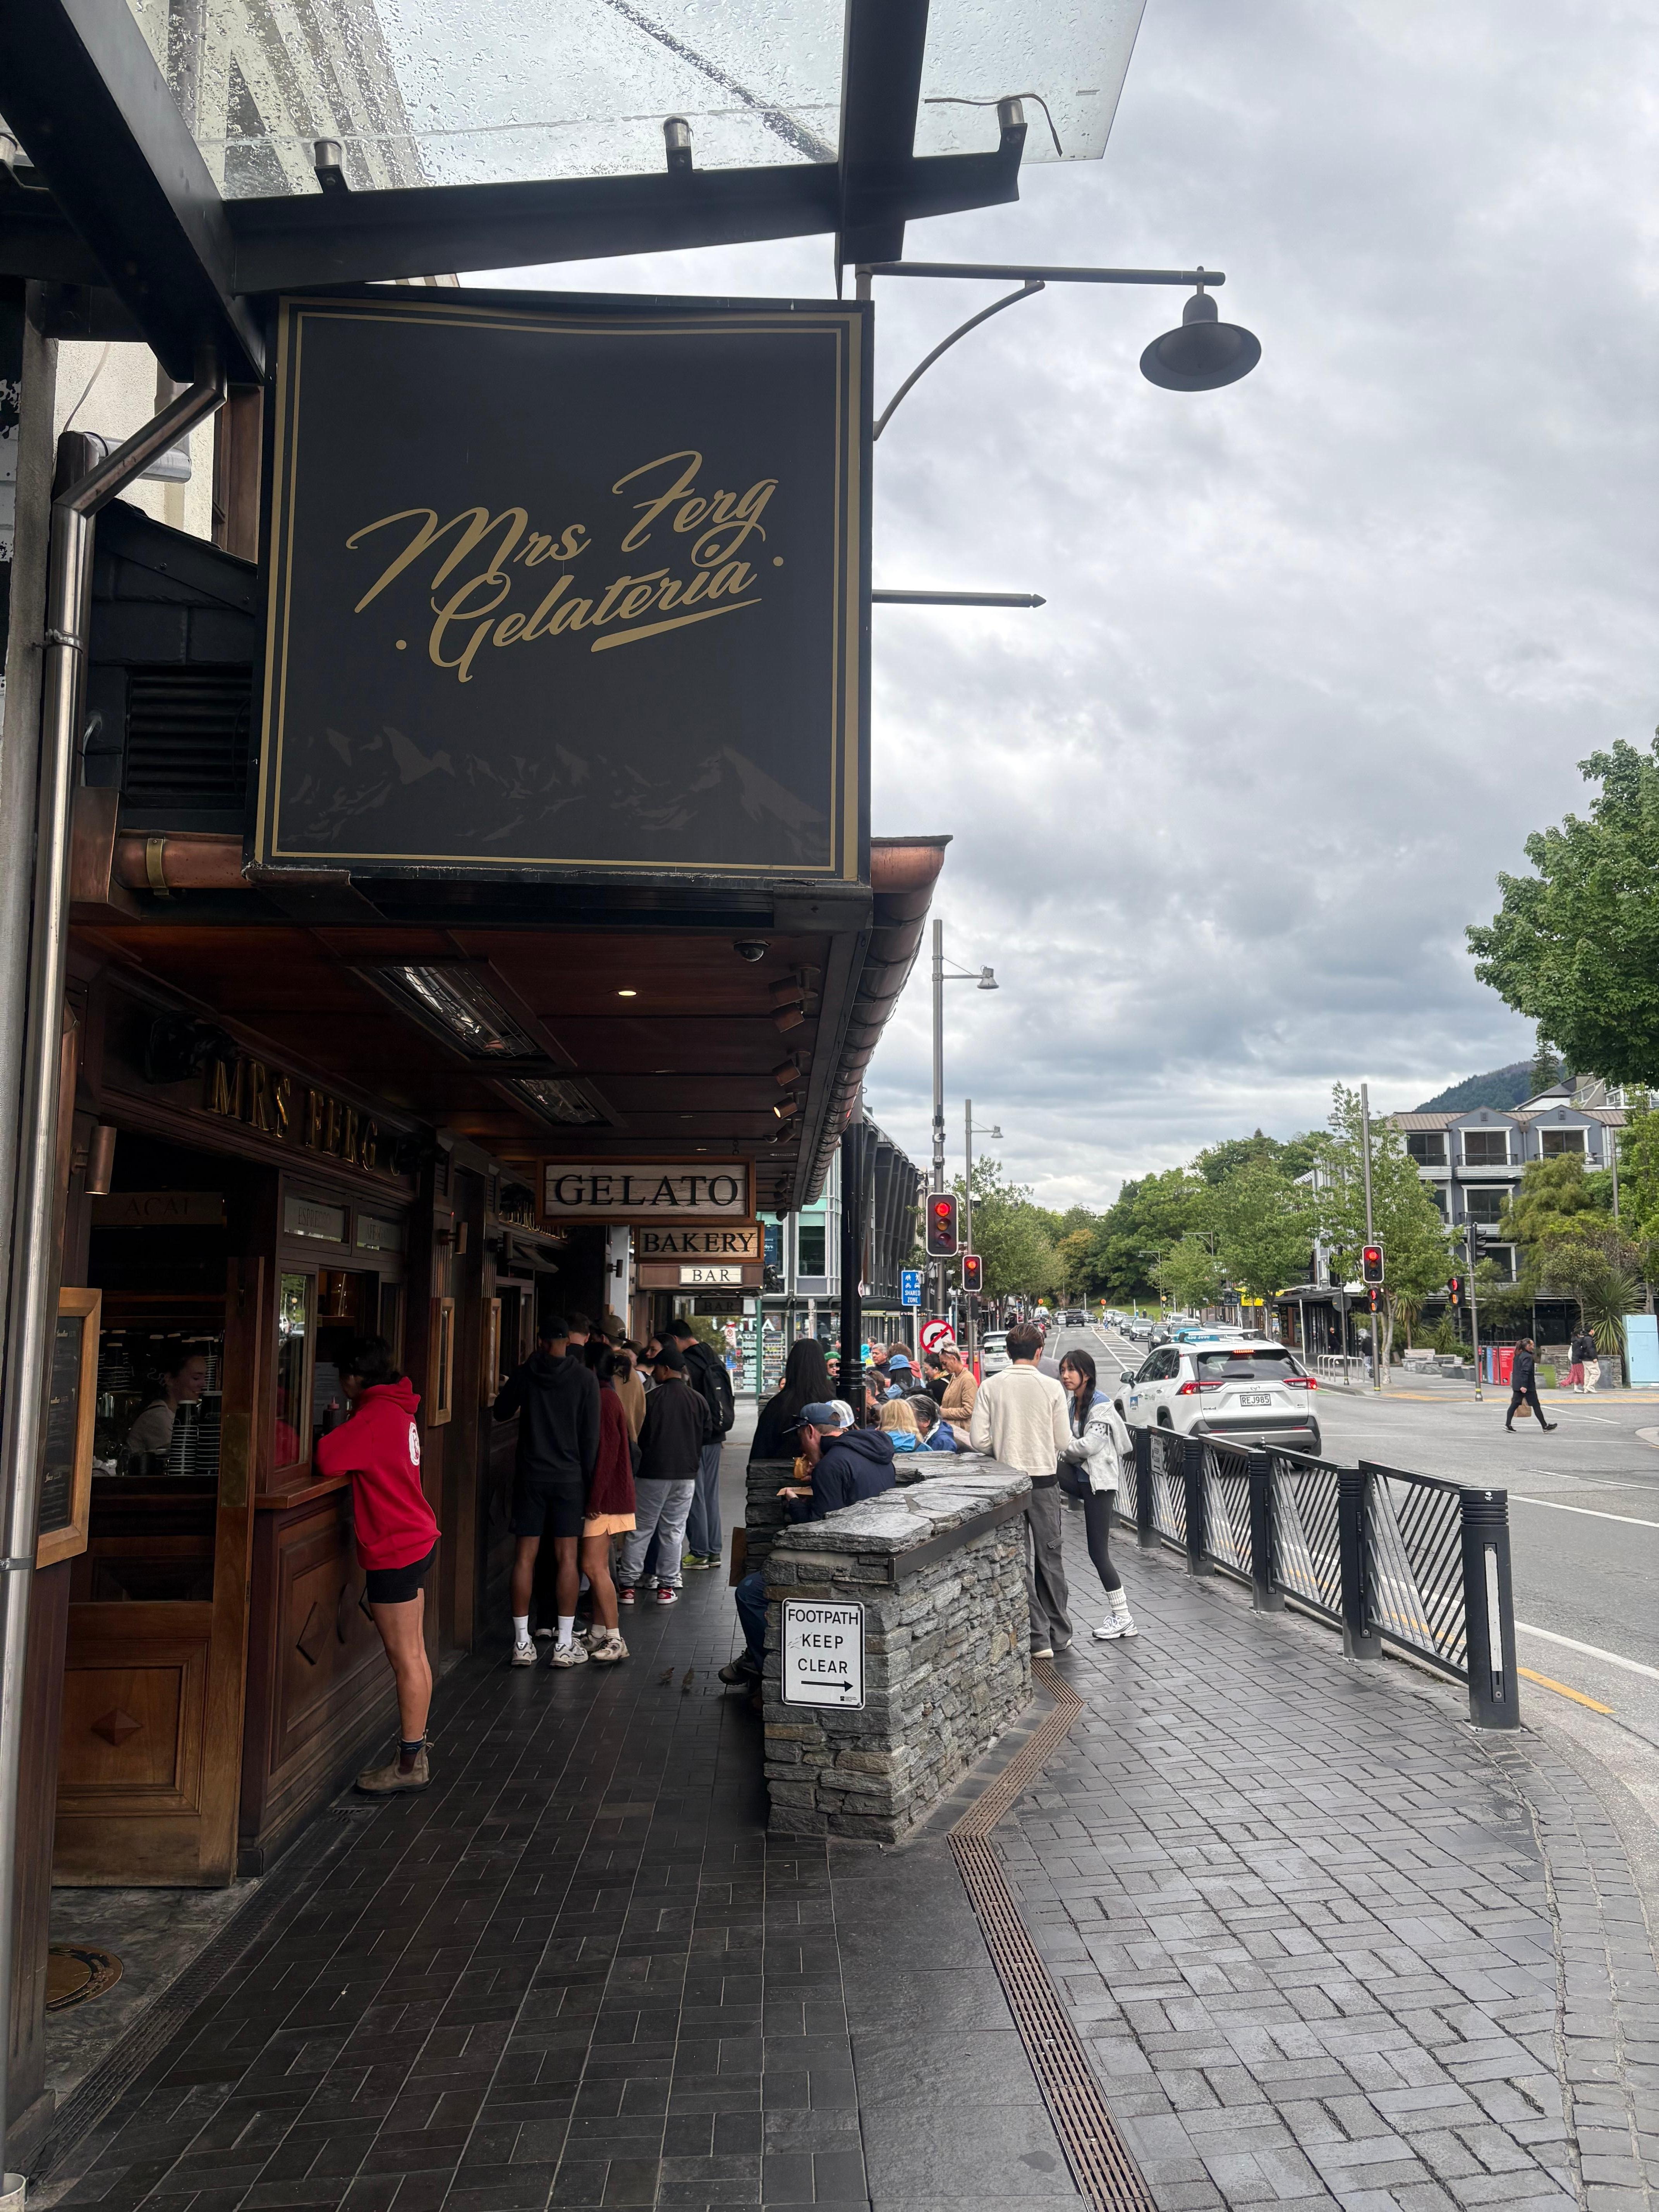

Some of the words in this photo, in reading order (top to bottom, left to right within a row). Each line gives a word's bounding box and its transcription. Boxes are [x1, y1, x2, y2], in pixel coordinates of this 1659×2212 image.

[345, 507, 591, 613] Mrs
[612, 450, 779, 568] Ferg
[429, 544, 758, 683] Gelateria
[207, 1058, 290, 1137] MRS
[306, 1088, 378, 1171] FERG
[555, 1174, 738, 1206] GELATO
[643, 1233, 756, 1252] BAKERY
[692, 1269, 730, 1282] BAR
[704, 1301, 734, 1311] BAR
[1242, 1396, 1269, 1404] REJ985
[788, 1609, 859, 1625] FOOTPATH
[802, 1633, 843, 1649] KEEP
[798, 1658, 848, 1674] CLEAR
